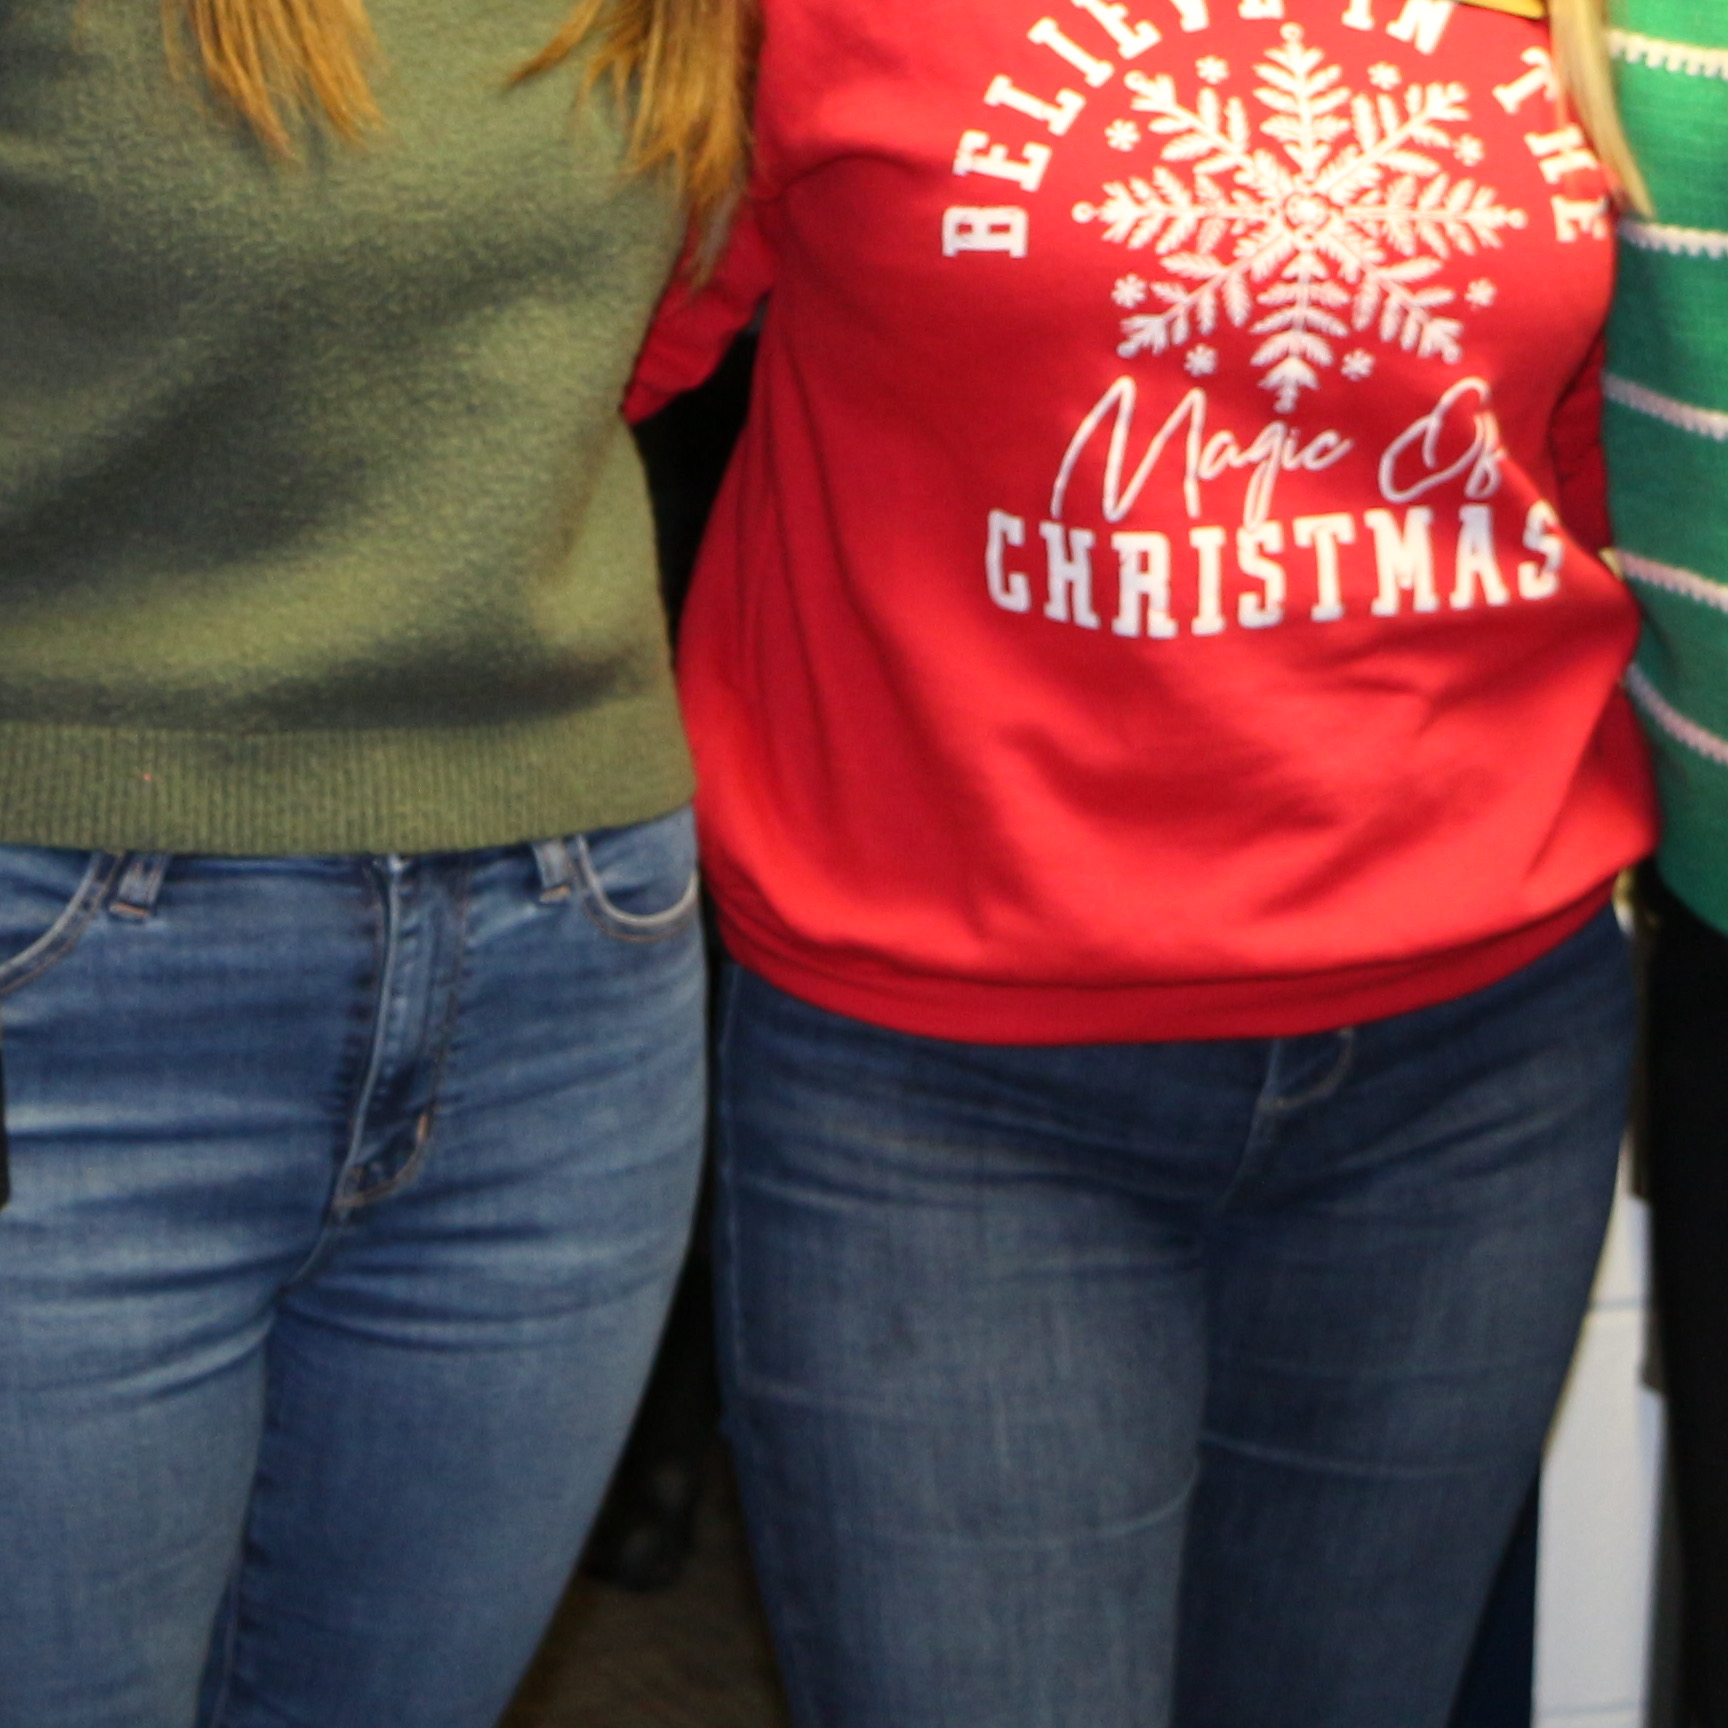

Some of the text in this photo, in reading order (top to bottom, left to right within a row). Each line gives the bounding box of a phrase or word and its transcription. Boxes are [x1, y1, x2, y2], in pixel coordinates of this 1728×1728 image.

[1491, 46, 1609, 244] THE
[1049, 375, 1355, 531] Magic
[984, 500, 1565, 639] CHRISTMAS
